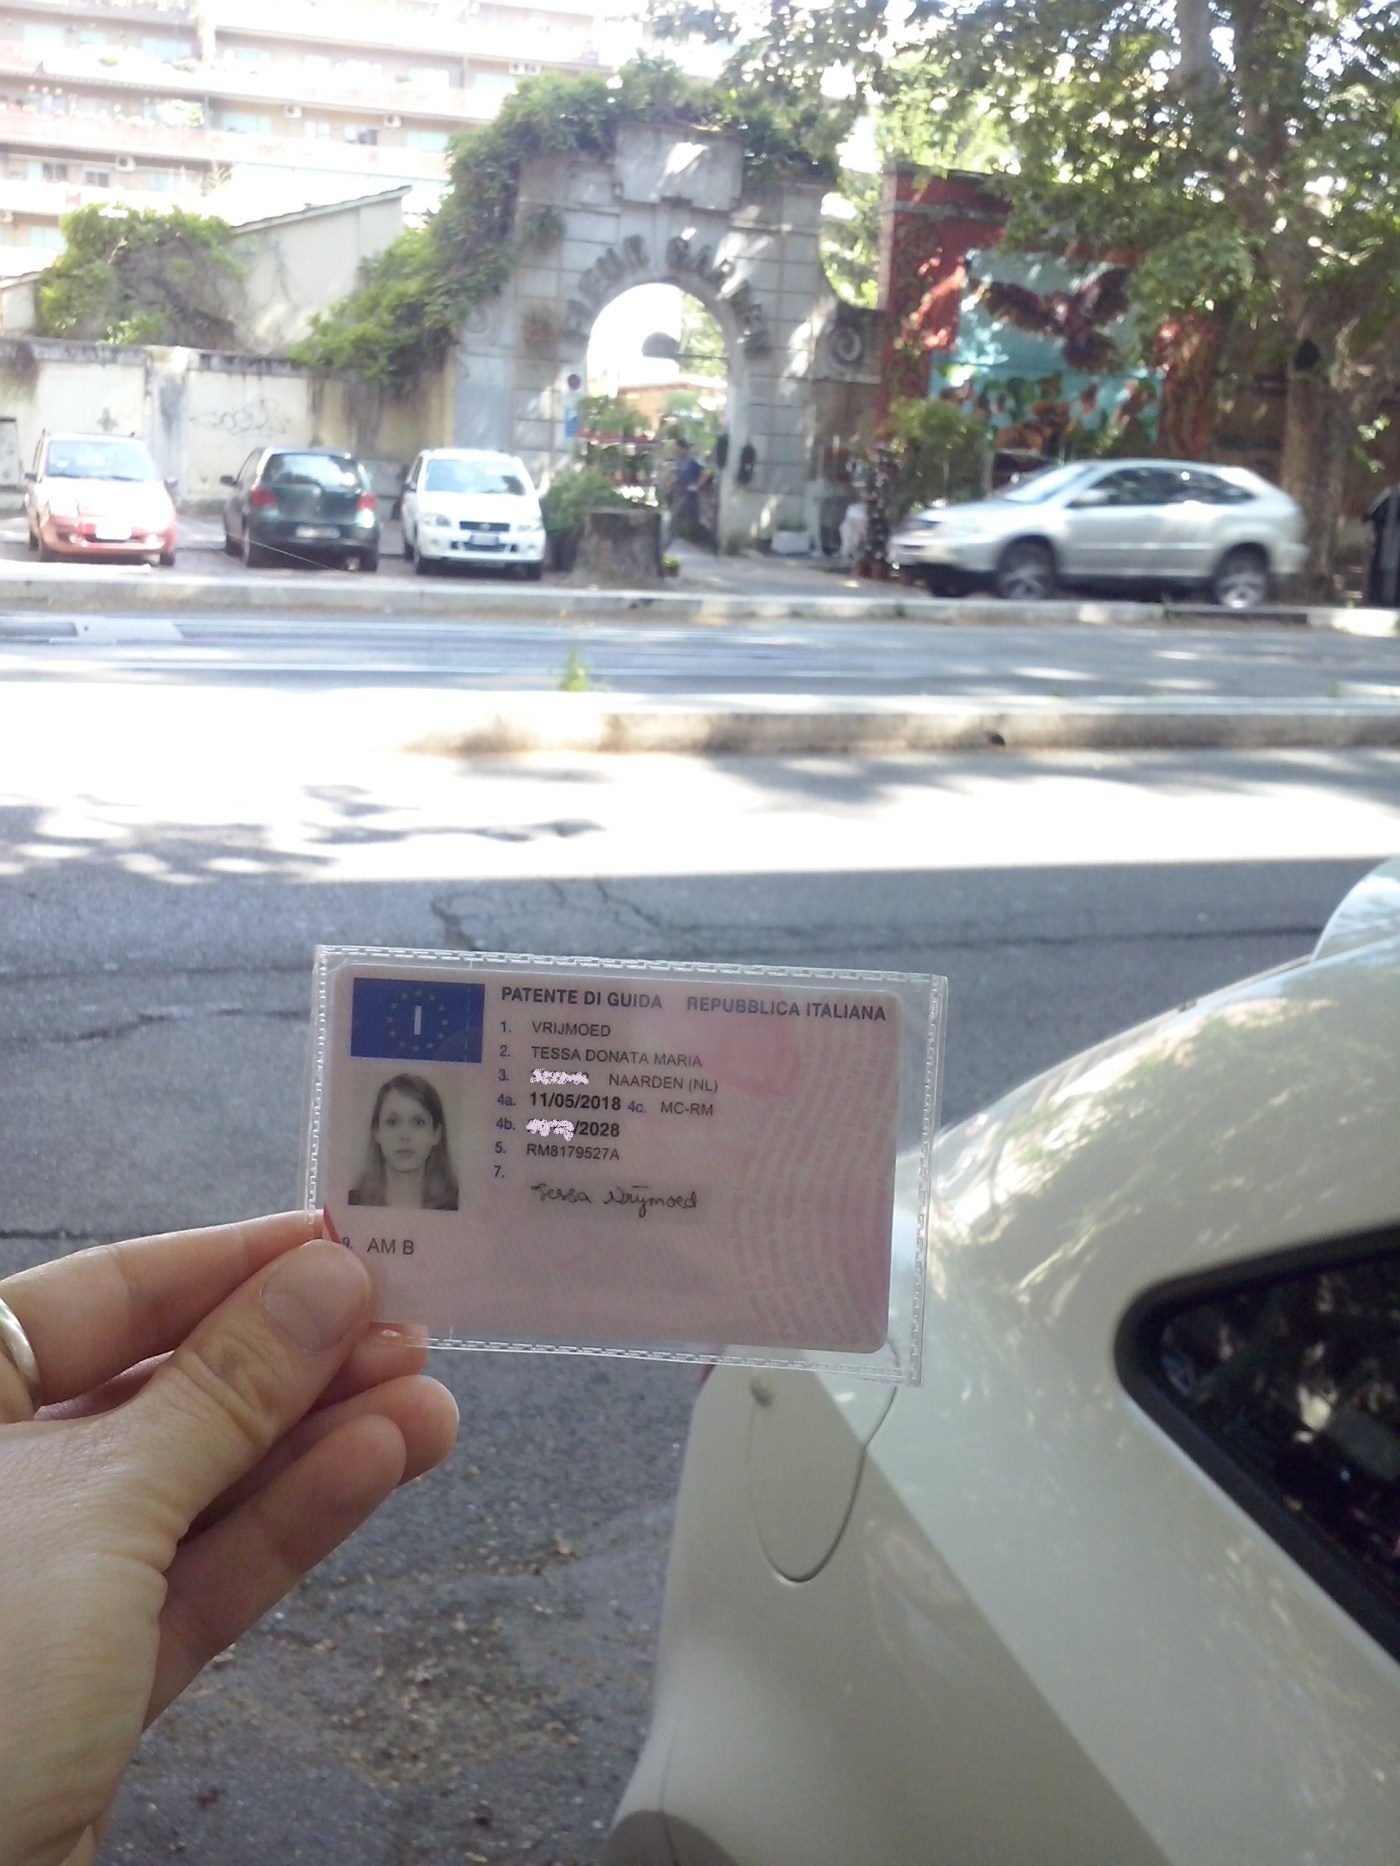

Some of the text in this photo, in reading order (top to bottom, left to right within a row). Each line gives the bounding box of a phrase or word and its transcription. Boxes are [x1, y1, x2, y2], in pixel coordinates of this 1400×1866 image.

[501, 987, 662, 1009] PATENTE DI GUIDA
[687, 996, 886, 1021] REPUBBLICA ITALIANA
[532, 1021, 611, 1037] VRIJMOED
[531, 1045, 581, 1061] TESSA
[585, 1049, 649, 1065] DONATA
[653, 1053, 703, 1068] MARIA
[609, 1073, 683, 1090] NAARDEN
[689, 1077, 718, 1094] (NL)
[530, 1091, 621, 1111] 11/05/2018
[660, 1101, 713, 1116] MC-RM
[526, 1118, 620, 1138] /2028
[526, 1143, 620, 1161] RM8179527A
[367, 1238, 396, 1255] AM
[402, 1239, 415, 1255] B
